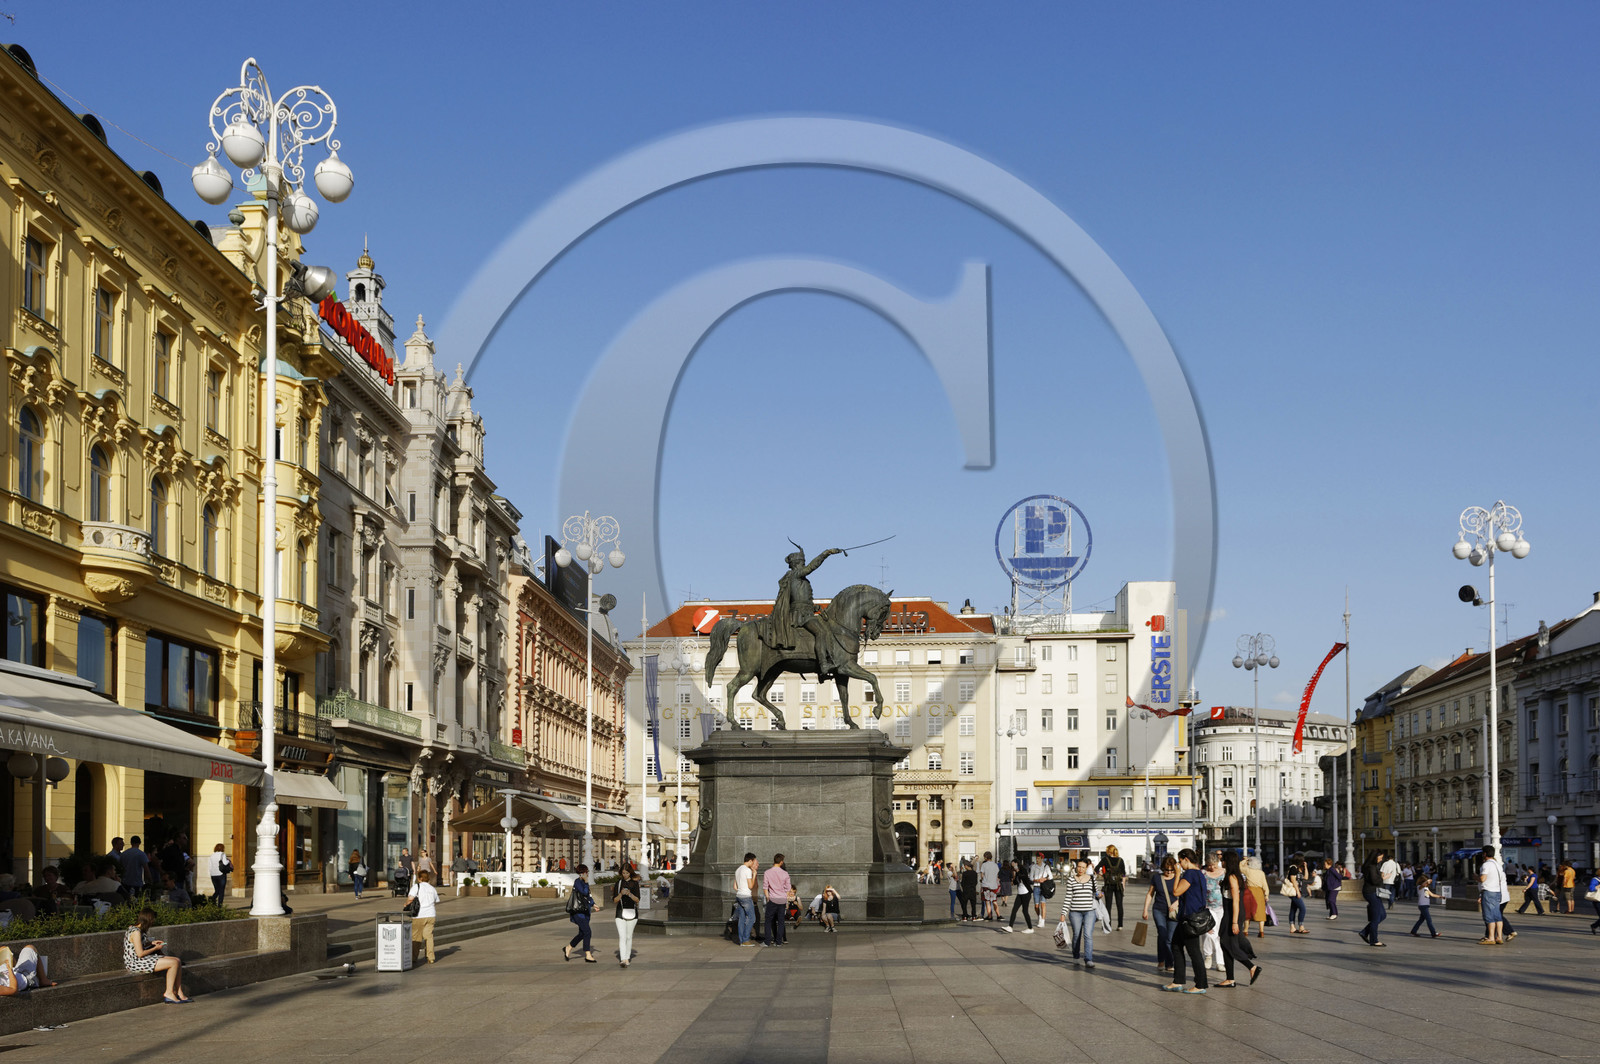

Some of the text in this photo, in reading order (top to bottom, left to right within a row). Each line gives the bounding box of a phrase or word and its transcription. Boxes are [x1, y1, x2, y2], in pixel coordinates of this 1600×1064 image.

[318, 294, 394, 386] KONZUM
[1150, 635, 1172, 703] ERSTE
[8, 729, 55, 750] KAVANA
